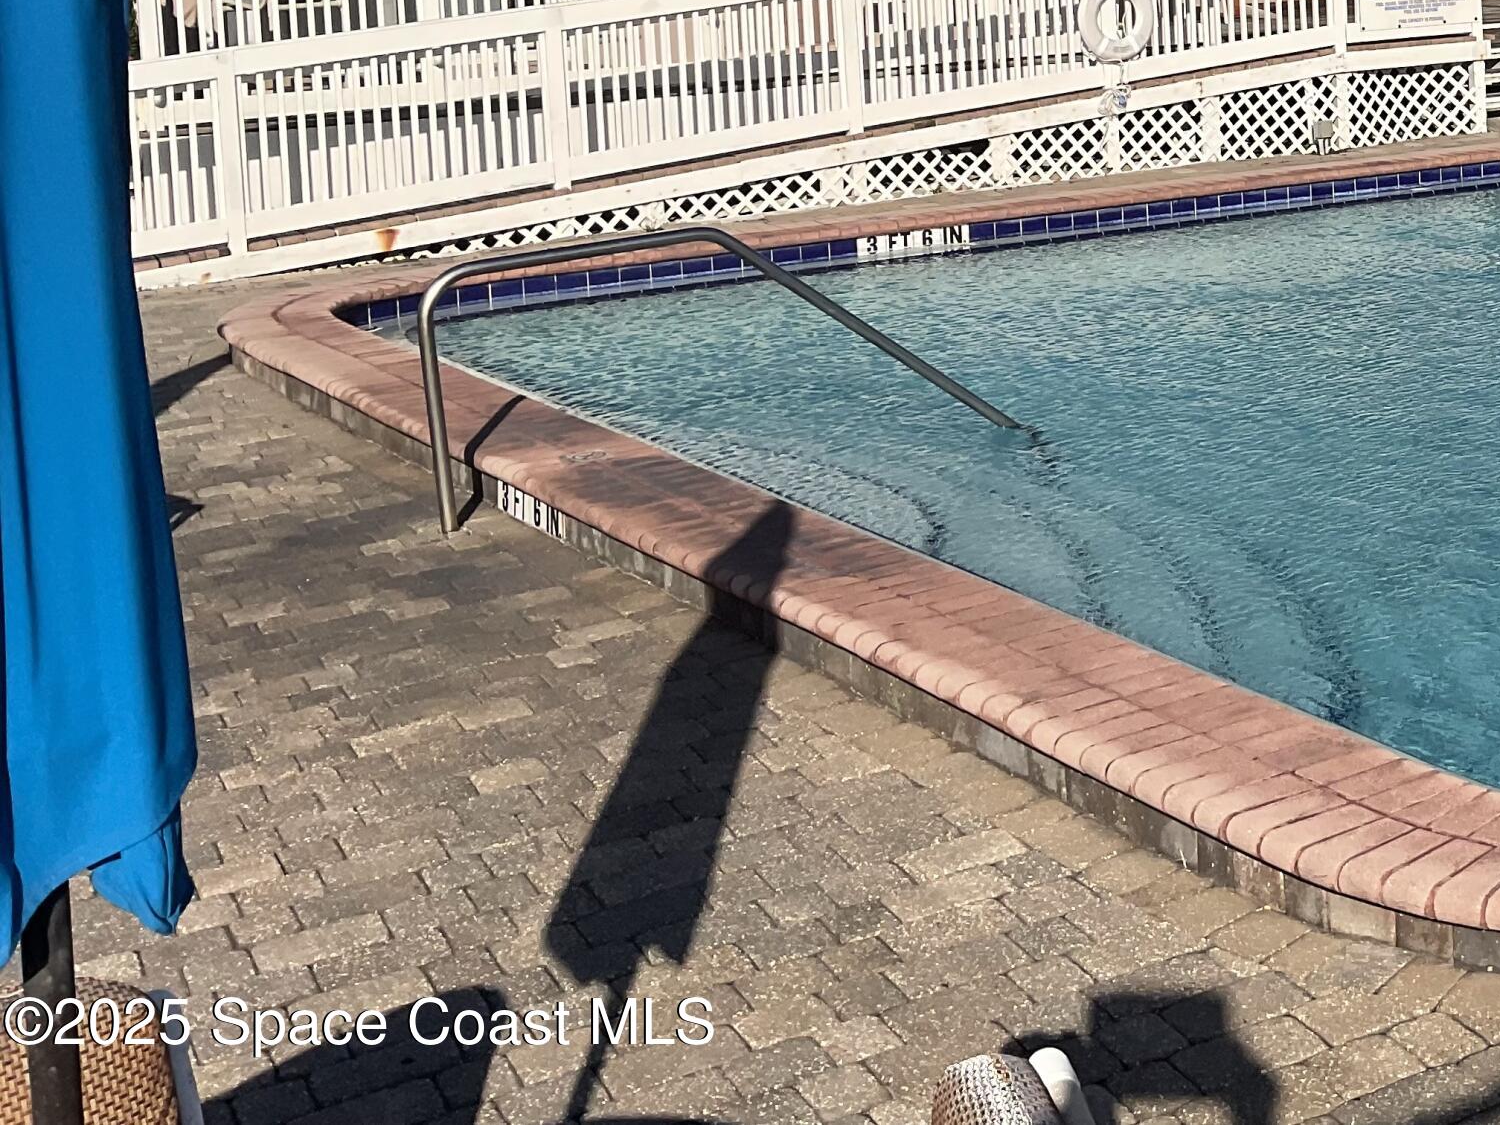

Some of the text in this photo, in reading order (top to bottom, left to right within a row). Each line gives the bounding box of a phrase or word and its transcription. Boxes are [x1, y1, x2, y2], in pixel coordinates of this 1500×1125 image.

[866, 235, 878, 254] 3
[888, 232, 911, 251] FT
[922, 229, 933, 247] 6
[502, 481, 509, 512] 3
[533, 497, 541, 527] 6
